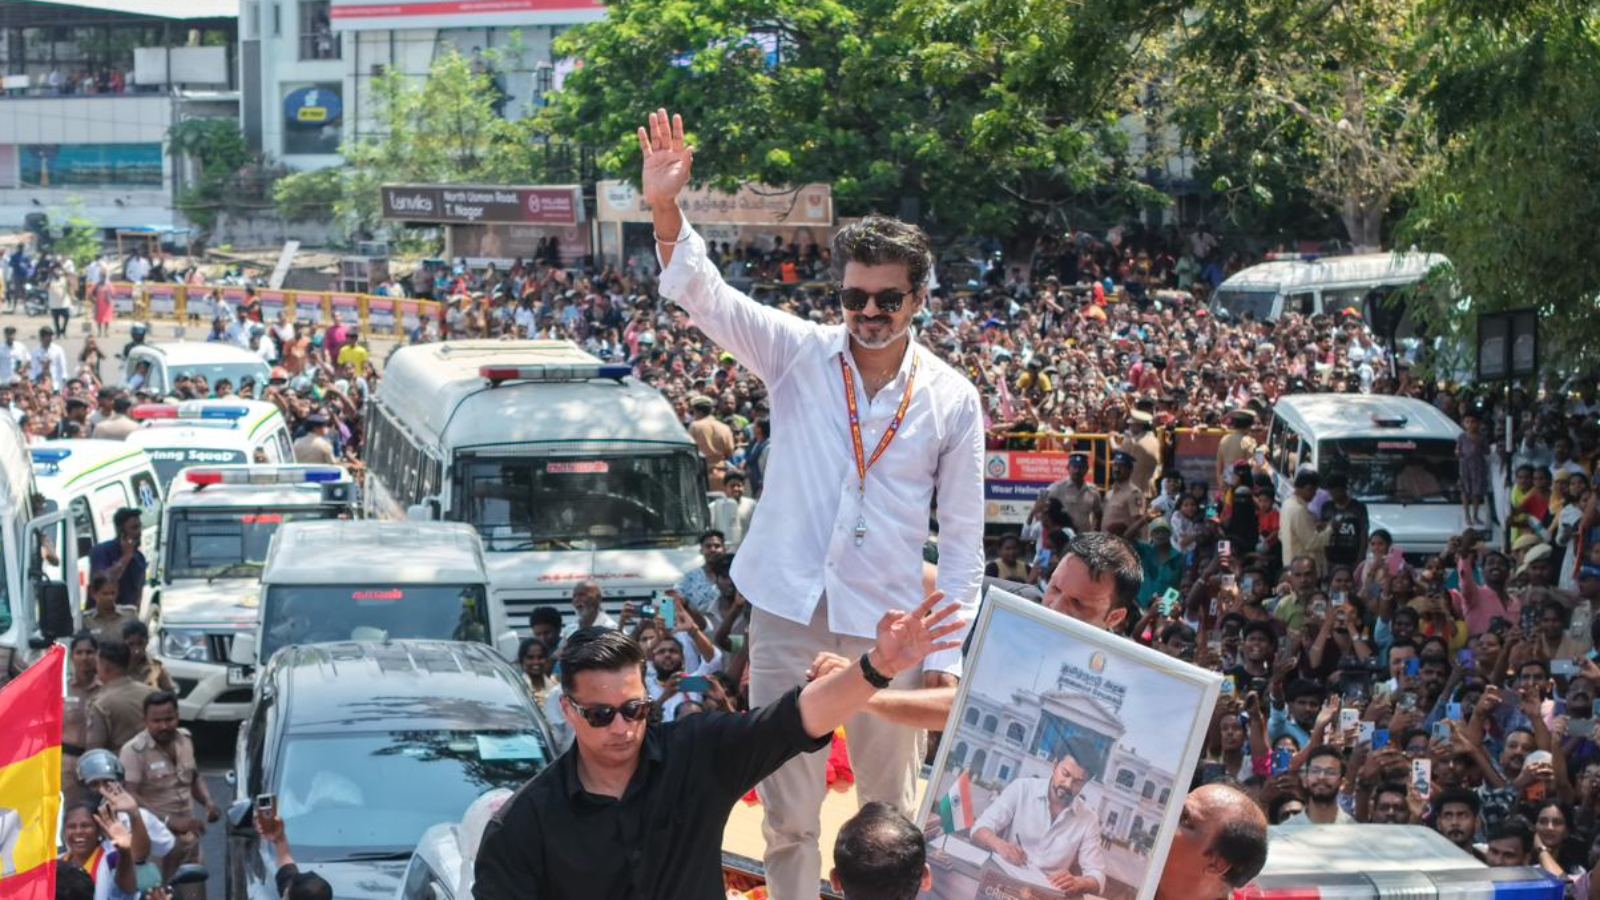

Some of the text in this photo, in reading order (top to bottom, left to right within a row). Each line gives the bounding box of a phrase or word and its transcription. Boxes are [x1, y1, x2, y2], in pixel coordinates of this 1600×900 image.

[443, 190, 465, 203] North
[454, 204, 484, 220] Nagar
[990, 484, 1013, 494] Wear
